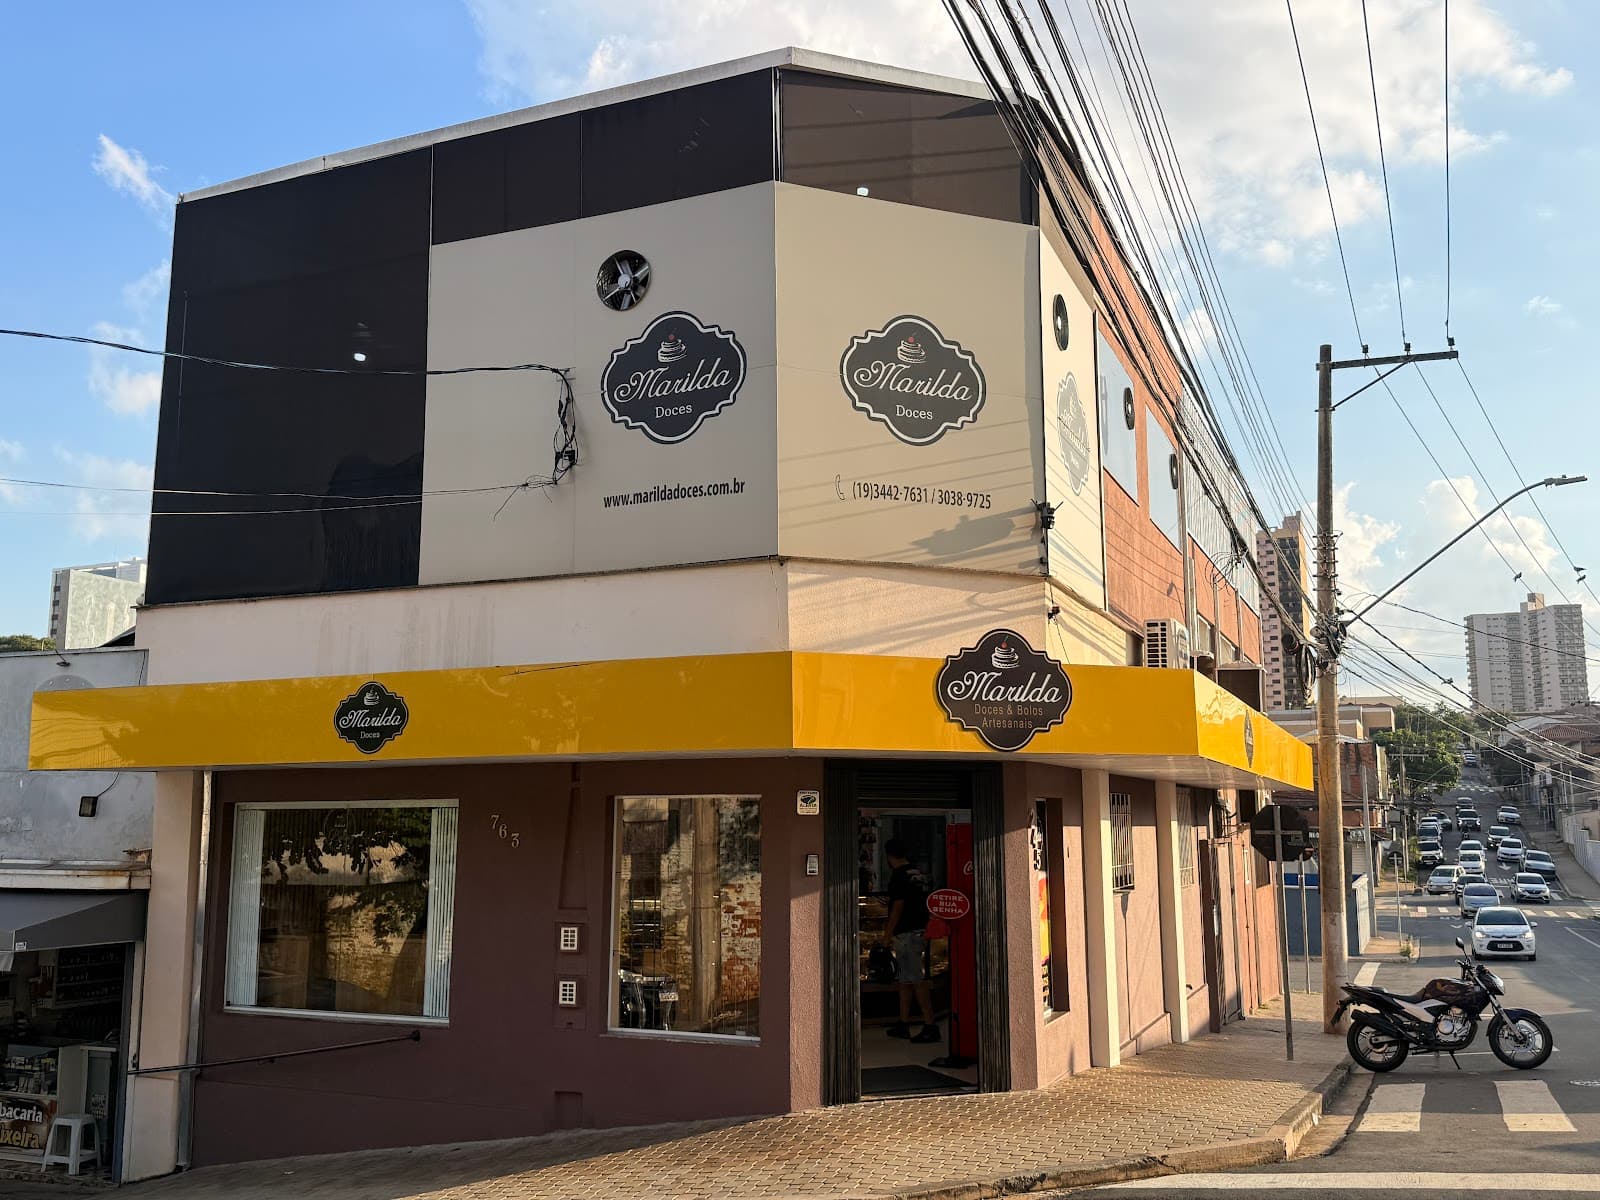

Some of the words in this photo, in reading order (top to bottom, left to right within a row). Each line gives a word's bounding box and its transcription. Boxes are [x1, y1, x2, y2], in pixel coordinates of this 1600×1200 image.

[614, 357, 734, 403] Marilda
[853, 360, 973, 401] Marilda
[655, 404, 693, 419] Doces
[896, 404, 934, 420] Doces
[603, 477, 746, 508] www.marildadoces.com.br
[937, 489, 992, 510] 3038-9725
[947, 670, 1063, 703] Marilda
[339, 707, 402, 729] Marilda
[974, 703, 1004, 715] Doces
[1006, 704, 1014, 715] &
[1017, 704, 1044, 716] Bolos
[982, 717, 1033, 729] Artesanais
[360, 731, 380, 739] Doces
[490, 814, 520, 849] 763
